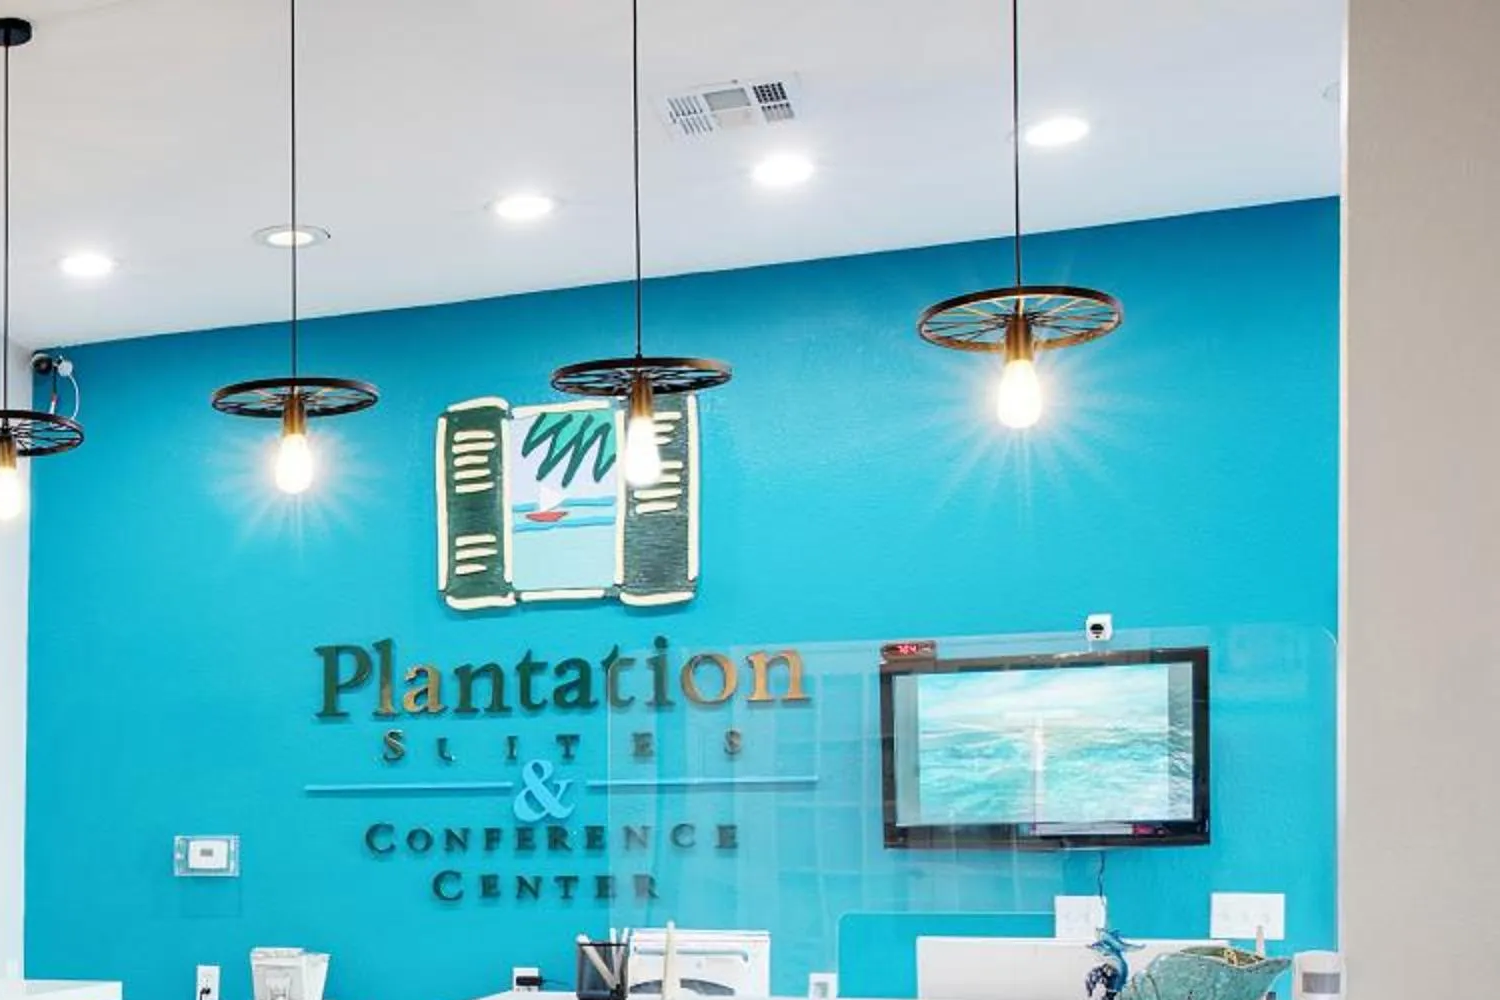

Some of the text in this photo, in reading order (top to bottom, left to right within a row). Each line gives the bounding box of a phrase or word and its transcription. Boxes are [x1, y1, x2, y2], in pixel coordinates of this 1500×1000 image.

[314, 636, 811, 717] Plantation
[513, 758, 576, 823] &
[365, 823, 739, 855] CONFERENCE
[432, 869, 661, 901] CENTER
